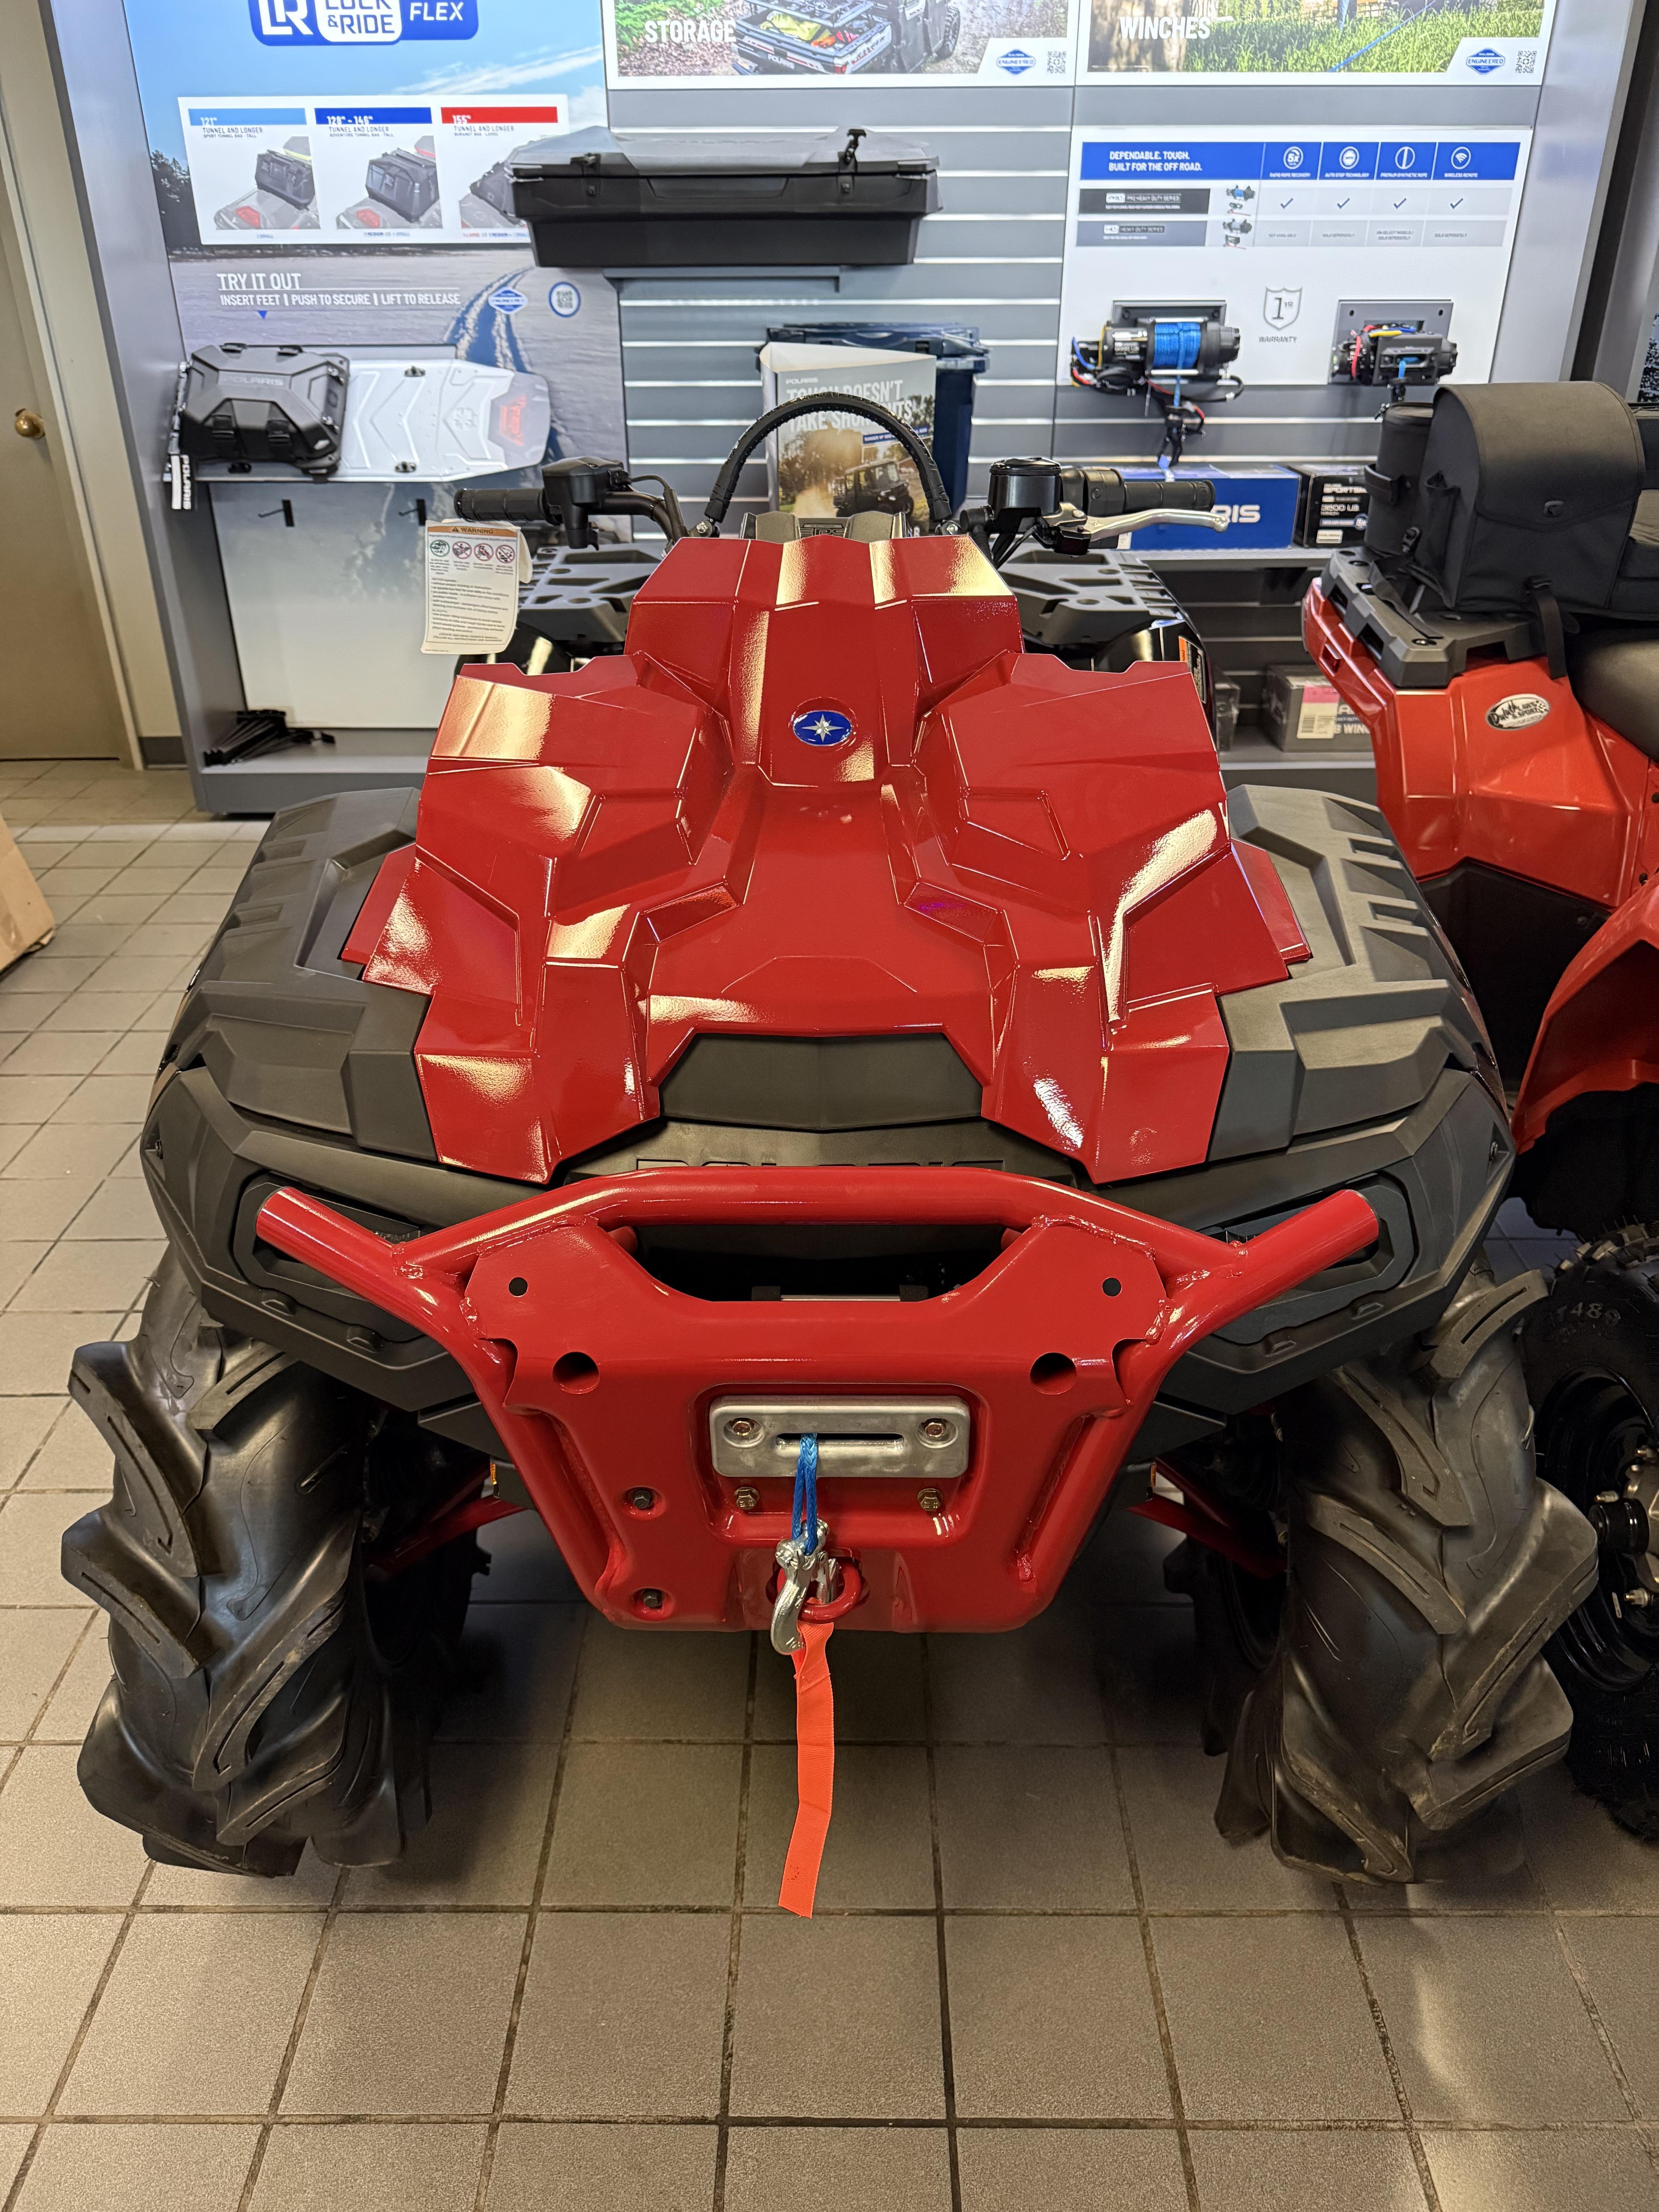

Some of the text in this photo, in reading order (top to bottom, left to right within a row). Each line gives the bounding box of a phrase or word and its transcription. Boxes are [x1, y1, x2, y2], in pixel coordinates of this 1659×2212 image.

[410, 2, 464, 21] FLEX
[328, 14, 395, 34] &RIDE
[644, 20, 736, 43] STORAGE
[1120, 15, 1211, 40] WINCHES
[1109, 151, 1190, 160] DEPENDABLE. TOUGH.
[1108, 162, 1202, 172] BUILT FOR THE OFF ROAD.
[216, 273, 301, 290] TRY IT OUT
[220, 294, 254, 305] INSERT
[256, 294, 280, 305] FEET
[292, 294, 318, 305] PUSH
[319, 294, 332, 305] TO
[333, 293, 371, 305] SECURE
[380, 293, 401, 305] LIFT
[402, 293, 417, 305] TO
[418, 293, 461, 305] RELEASE
[1272, 297, 1284, 320] 1
[180, 454, 191, 510] POLARIS
[1210, 504, 1261, 523] RIS
